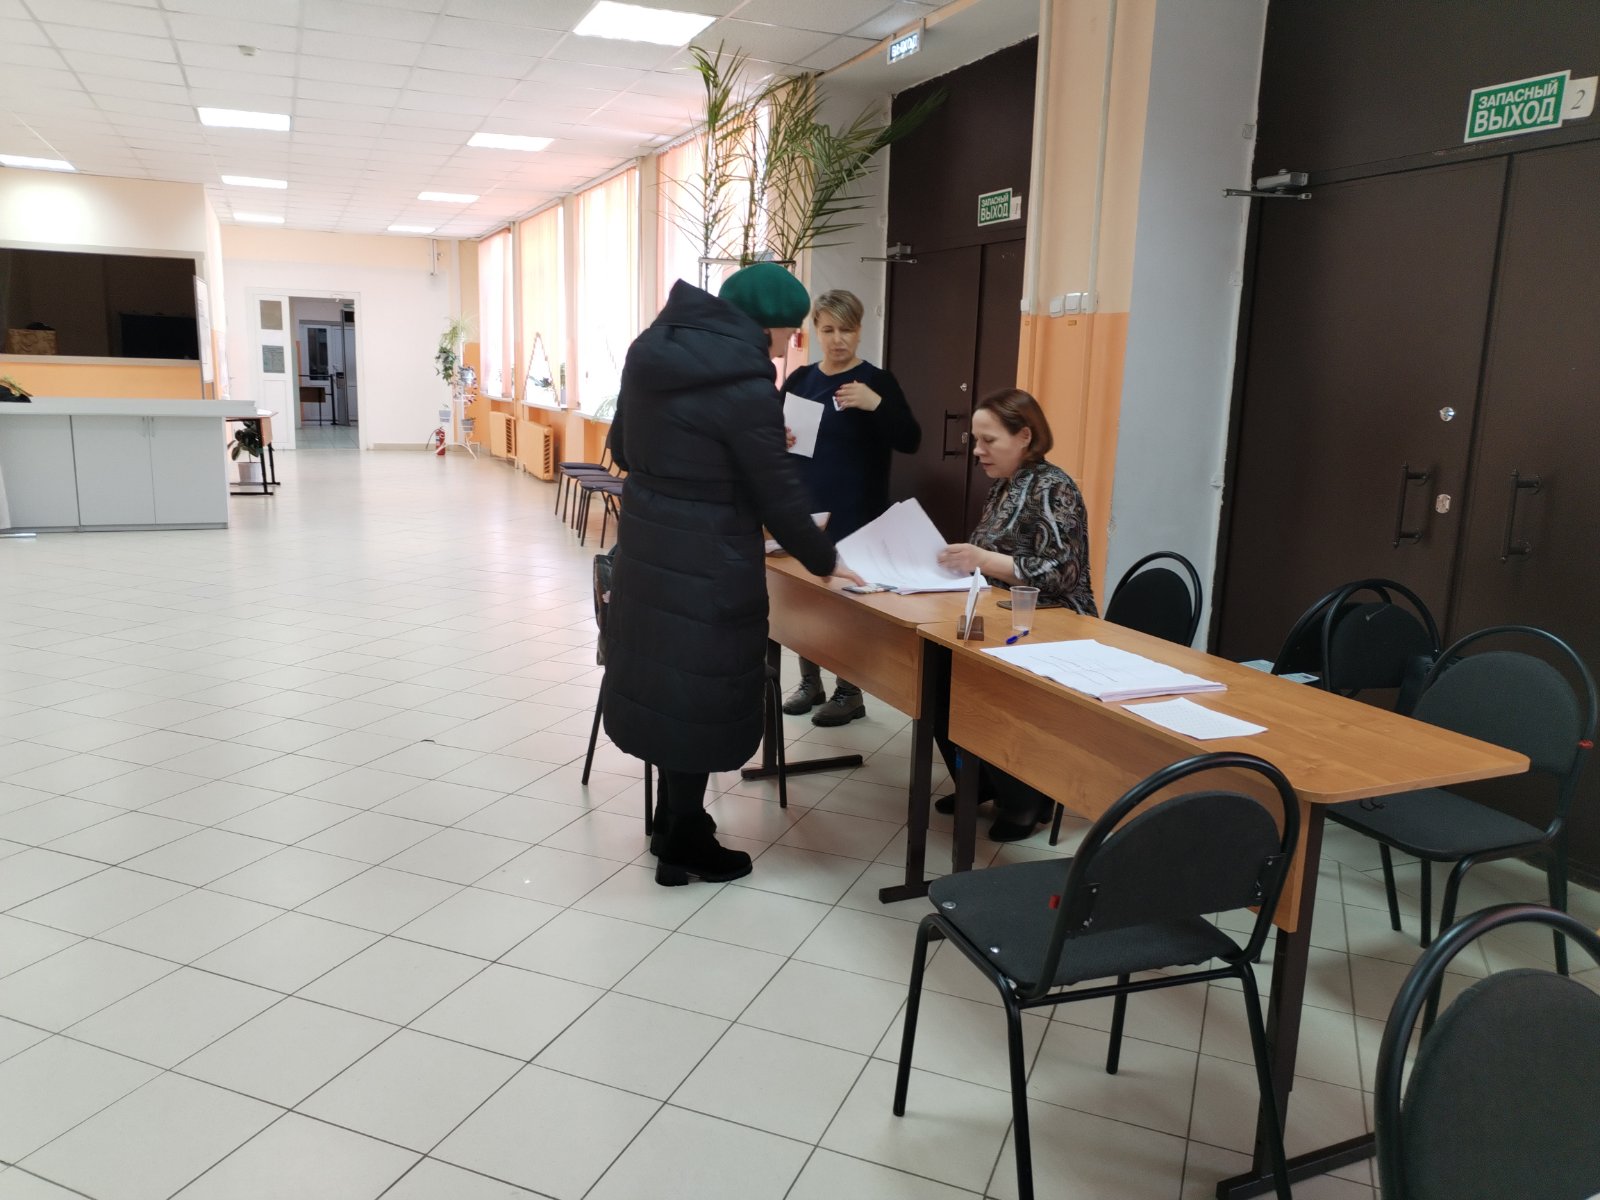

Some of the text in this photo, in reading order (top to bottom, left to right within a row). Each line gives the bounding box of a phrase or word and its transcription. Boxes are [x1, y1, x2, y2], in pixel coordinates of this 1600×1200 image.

[1478, 80, 1559, 109] ЗАПАСНЫЙ
[1571, 89, 1586, 110] 2
[1473, 97, 1556, 133] ВЫХОД
[980, 202, 1009, 221] ВЫХОД
